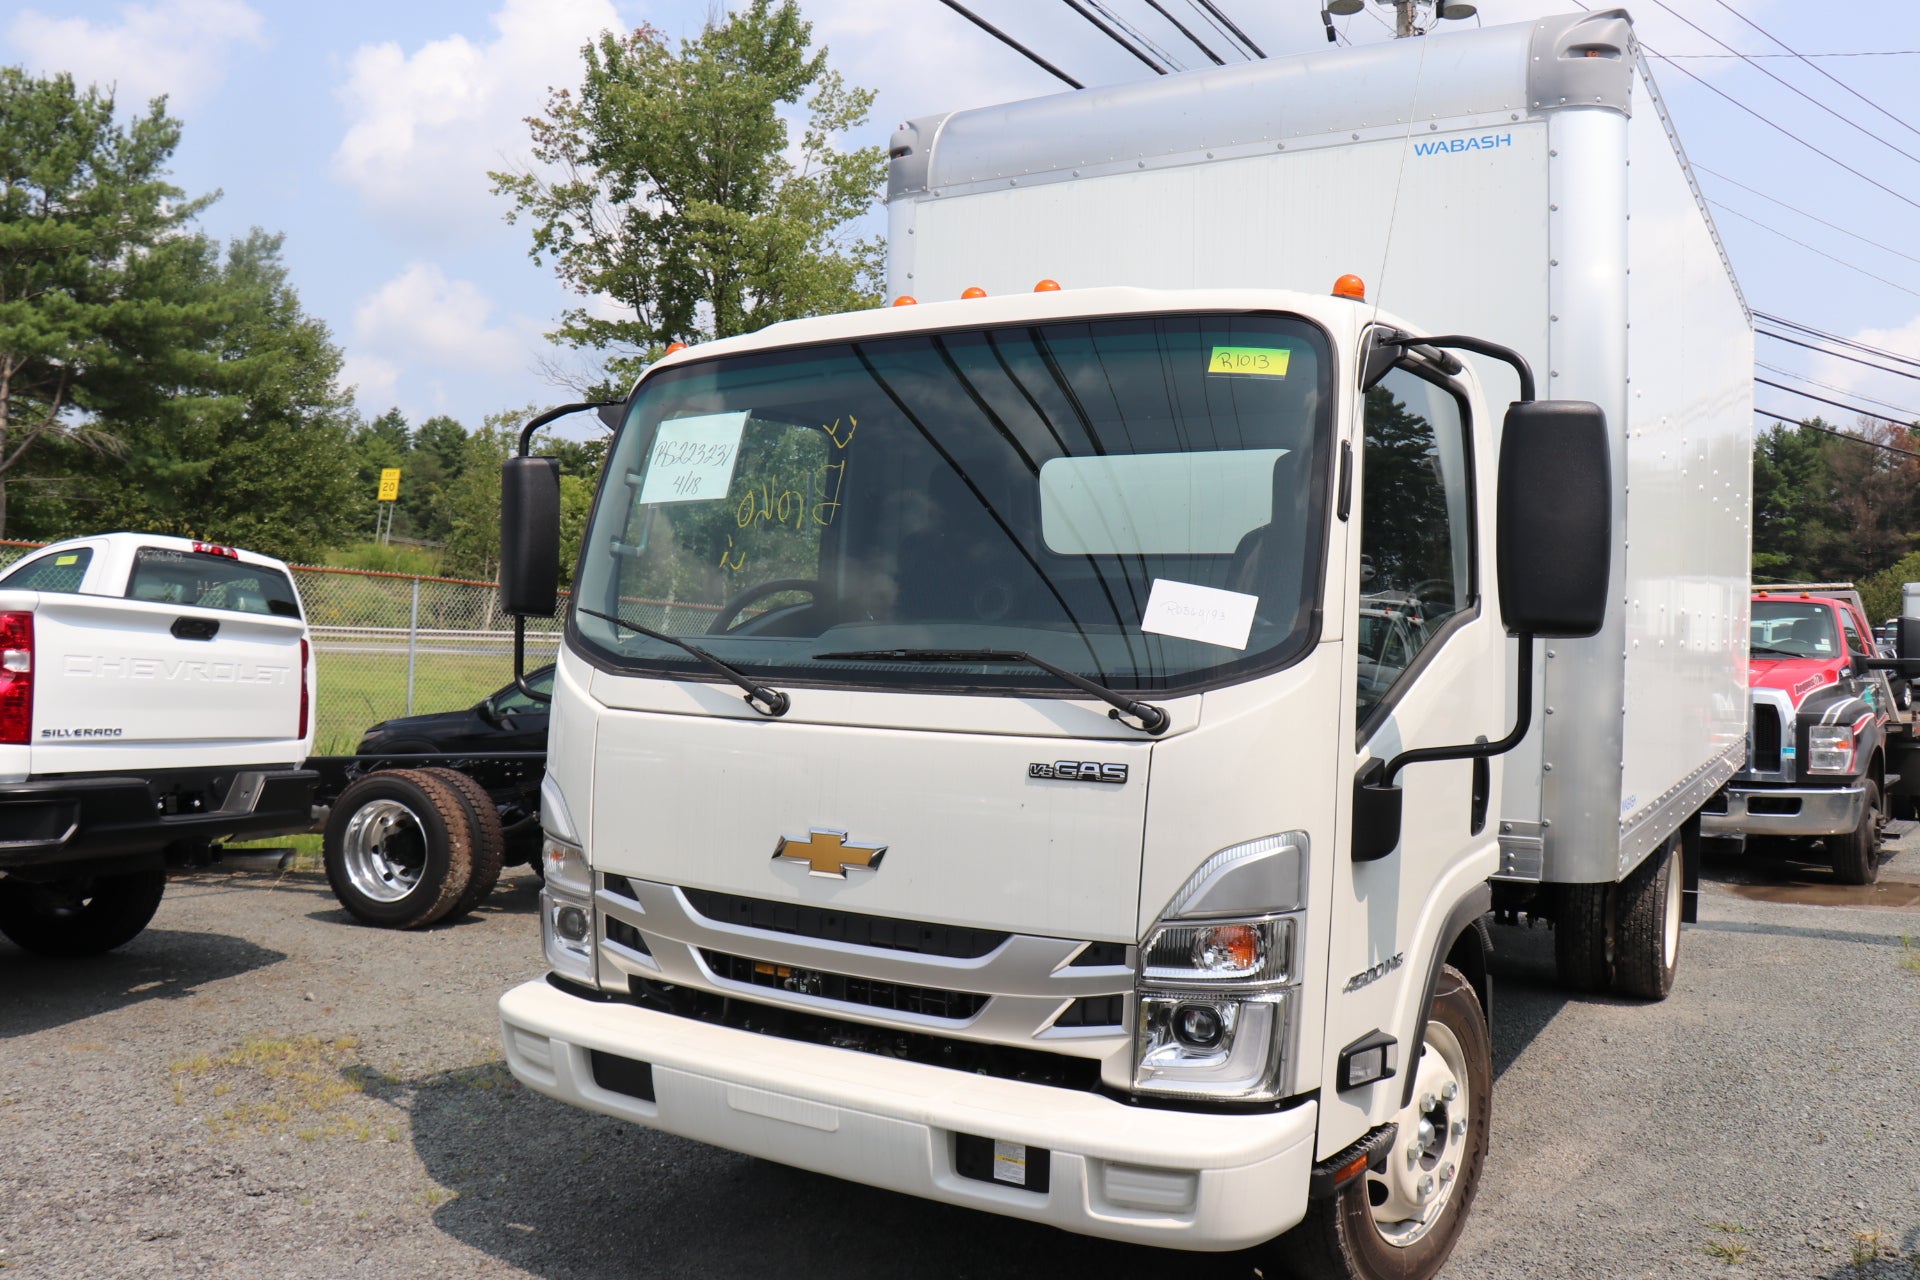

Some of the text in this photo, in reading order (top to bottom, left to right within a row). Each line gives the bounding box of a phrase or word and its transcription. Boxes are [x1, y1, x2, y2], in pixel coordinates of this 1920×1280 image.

[1413, 133, 1512, 157] WABASH
[1215, 351, 1270, 370] R1013
[382, 481, 396, 492] 20
[672, 470, 703, 496] 4/18
[62, 653, 291, 685] CHEVROLET
[41, 727, 122, 737] SILVERADO
[1053, 760, 1129, 784] GAS
